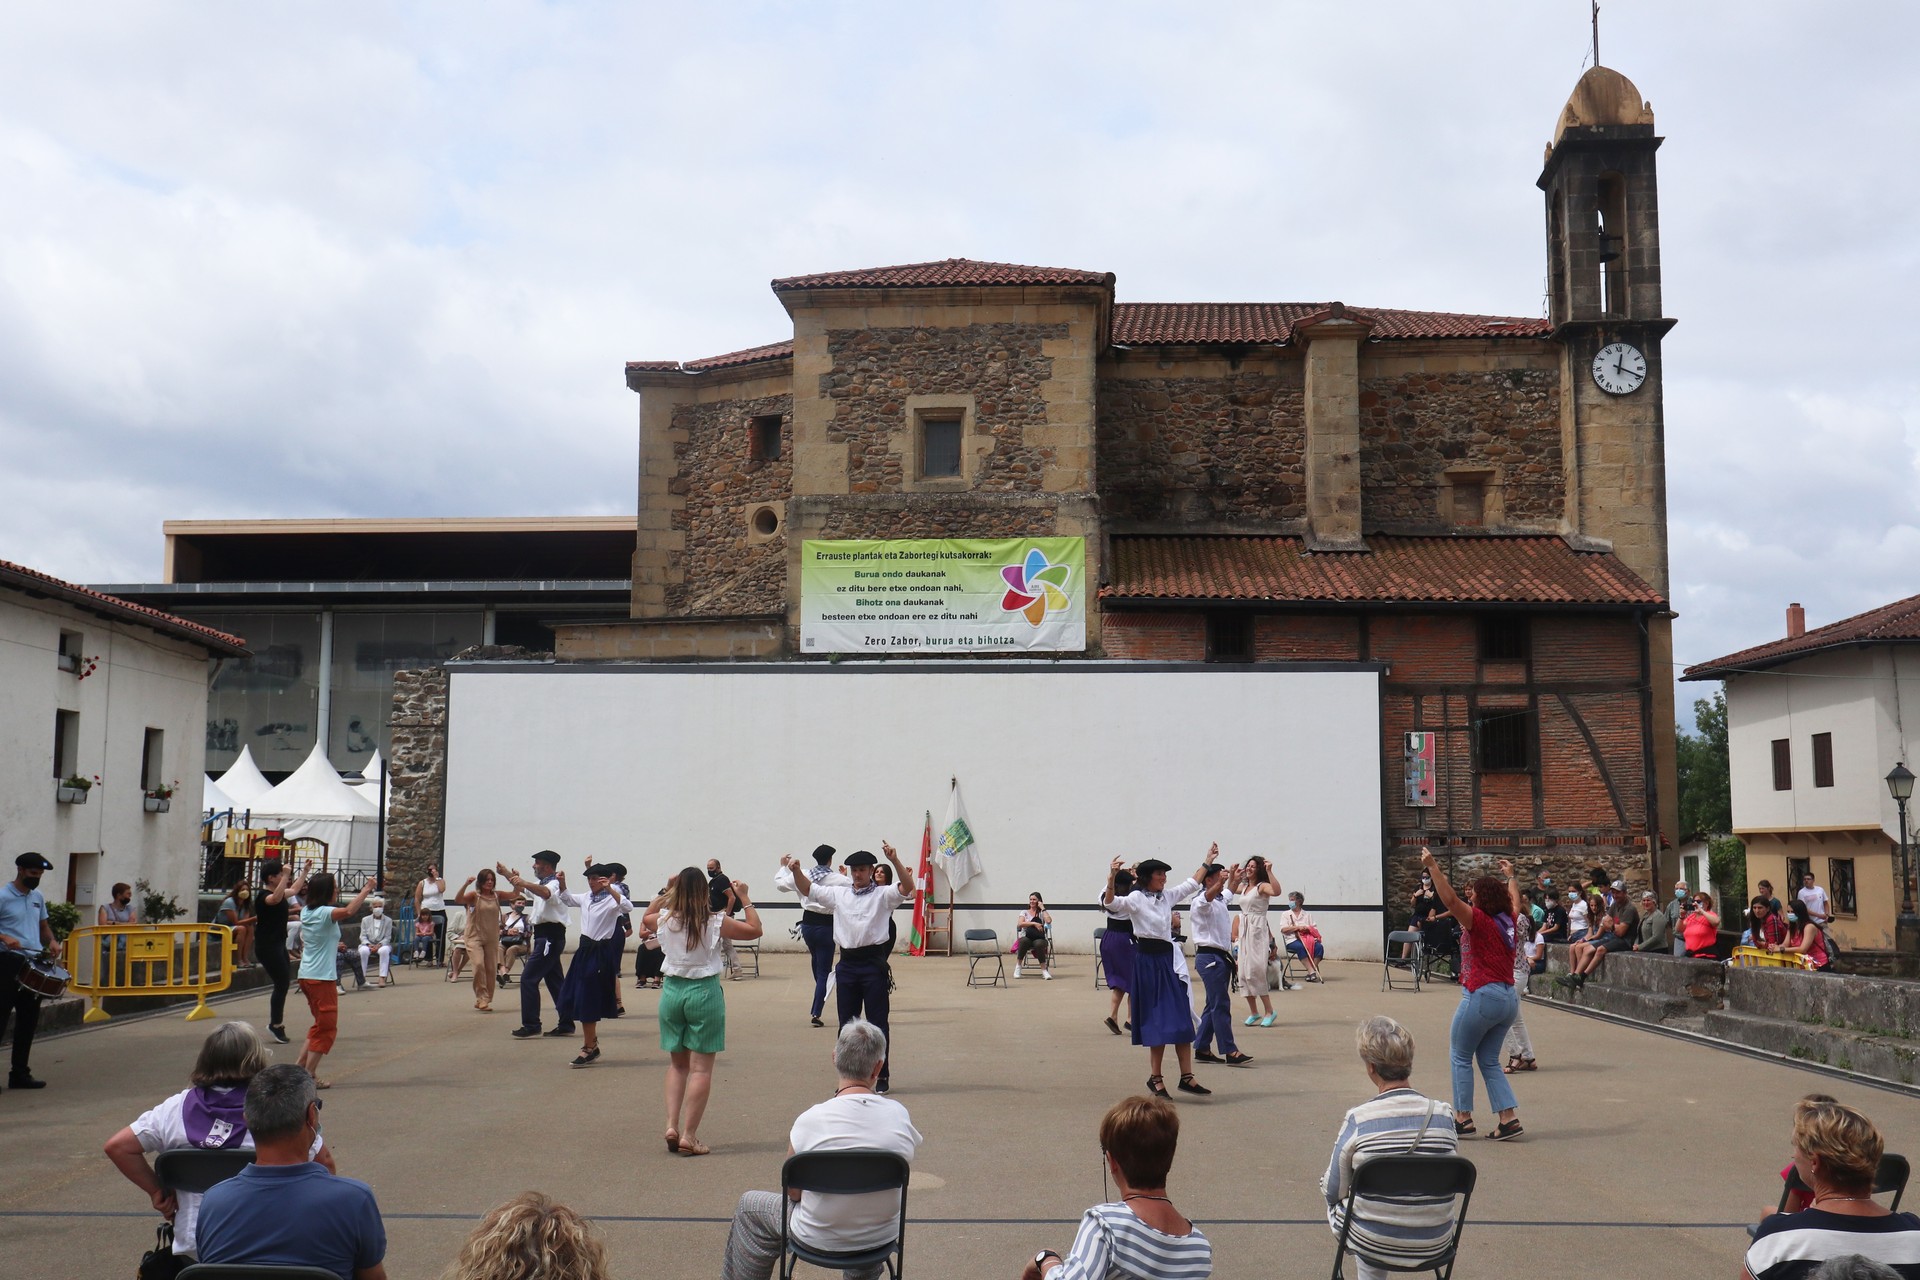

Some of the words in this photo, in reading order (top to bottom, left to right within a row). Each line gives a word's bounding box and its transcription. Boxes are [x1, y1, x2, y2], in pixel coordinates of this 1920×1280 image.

[853, 552, 882, 561] plantak
[899, 551, 938, 560] Zabortegi
[940, 551, 992, 559] kutsakorrak:
[944, 584, 964, 592] nahi,
[865, 636, 886, 645] Zero
[891, 636, 921, 646] Zabor,
[926, 636, 954, 645] burua
[958, 637, 973, 645] eta
[978, 636, 1015, 645] bihotza
